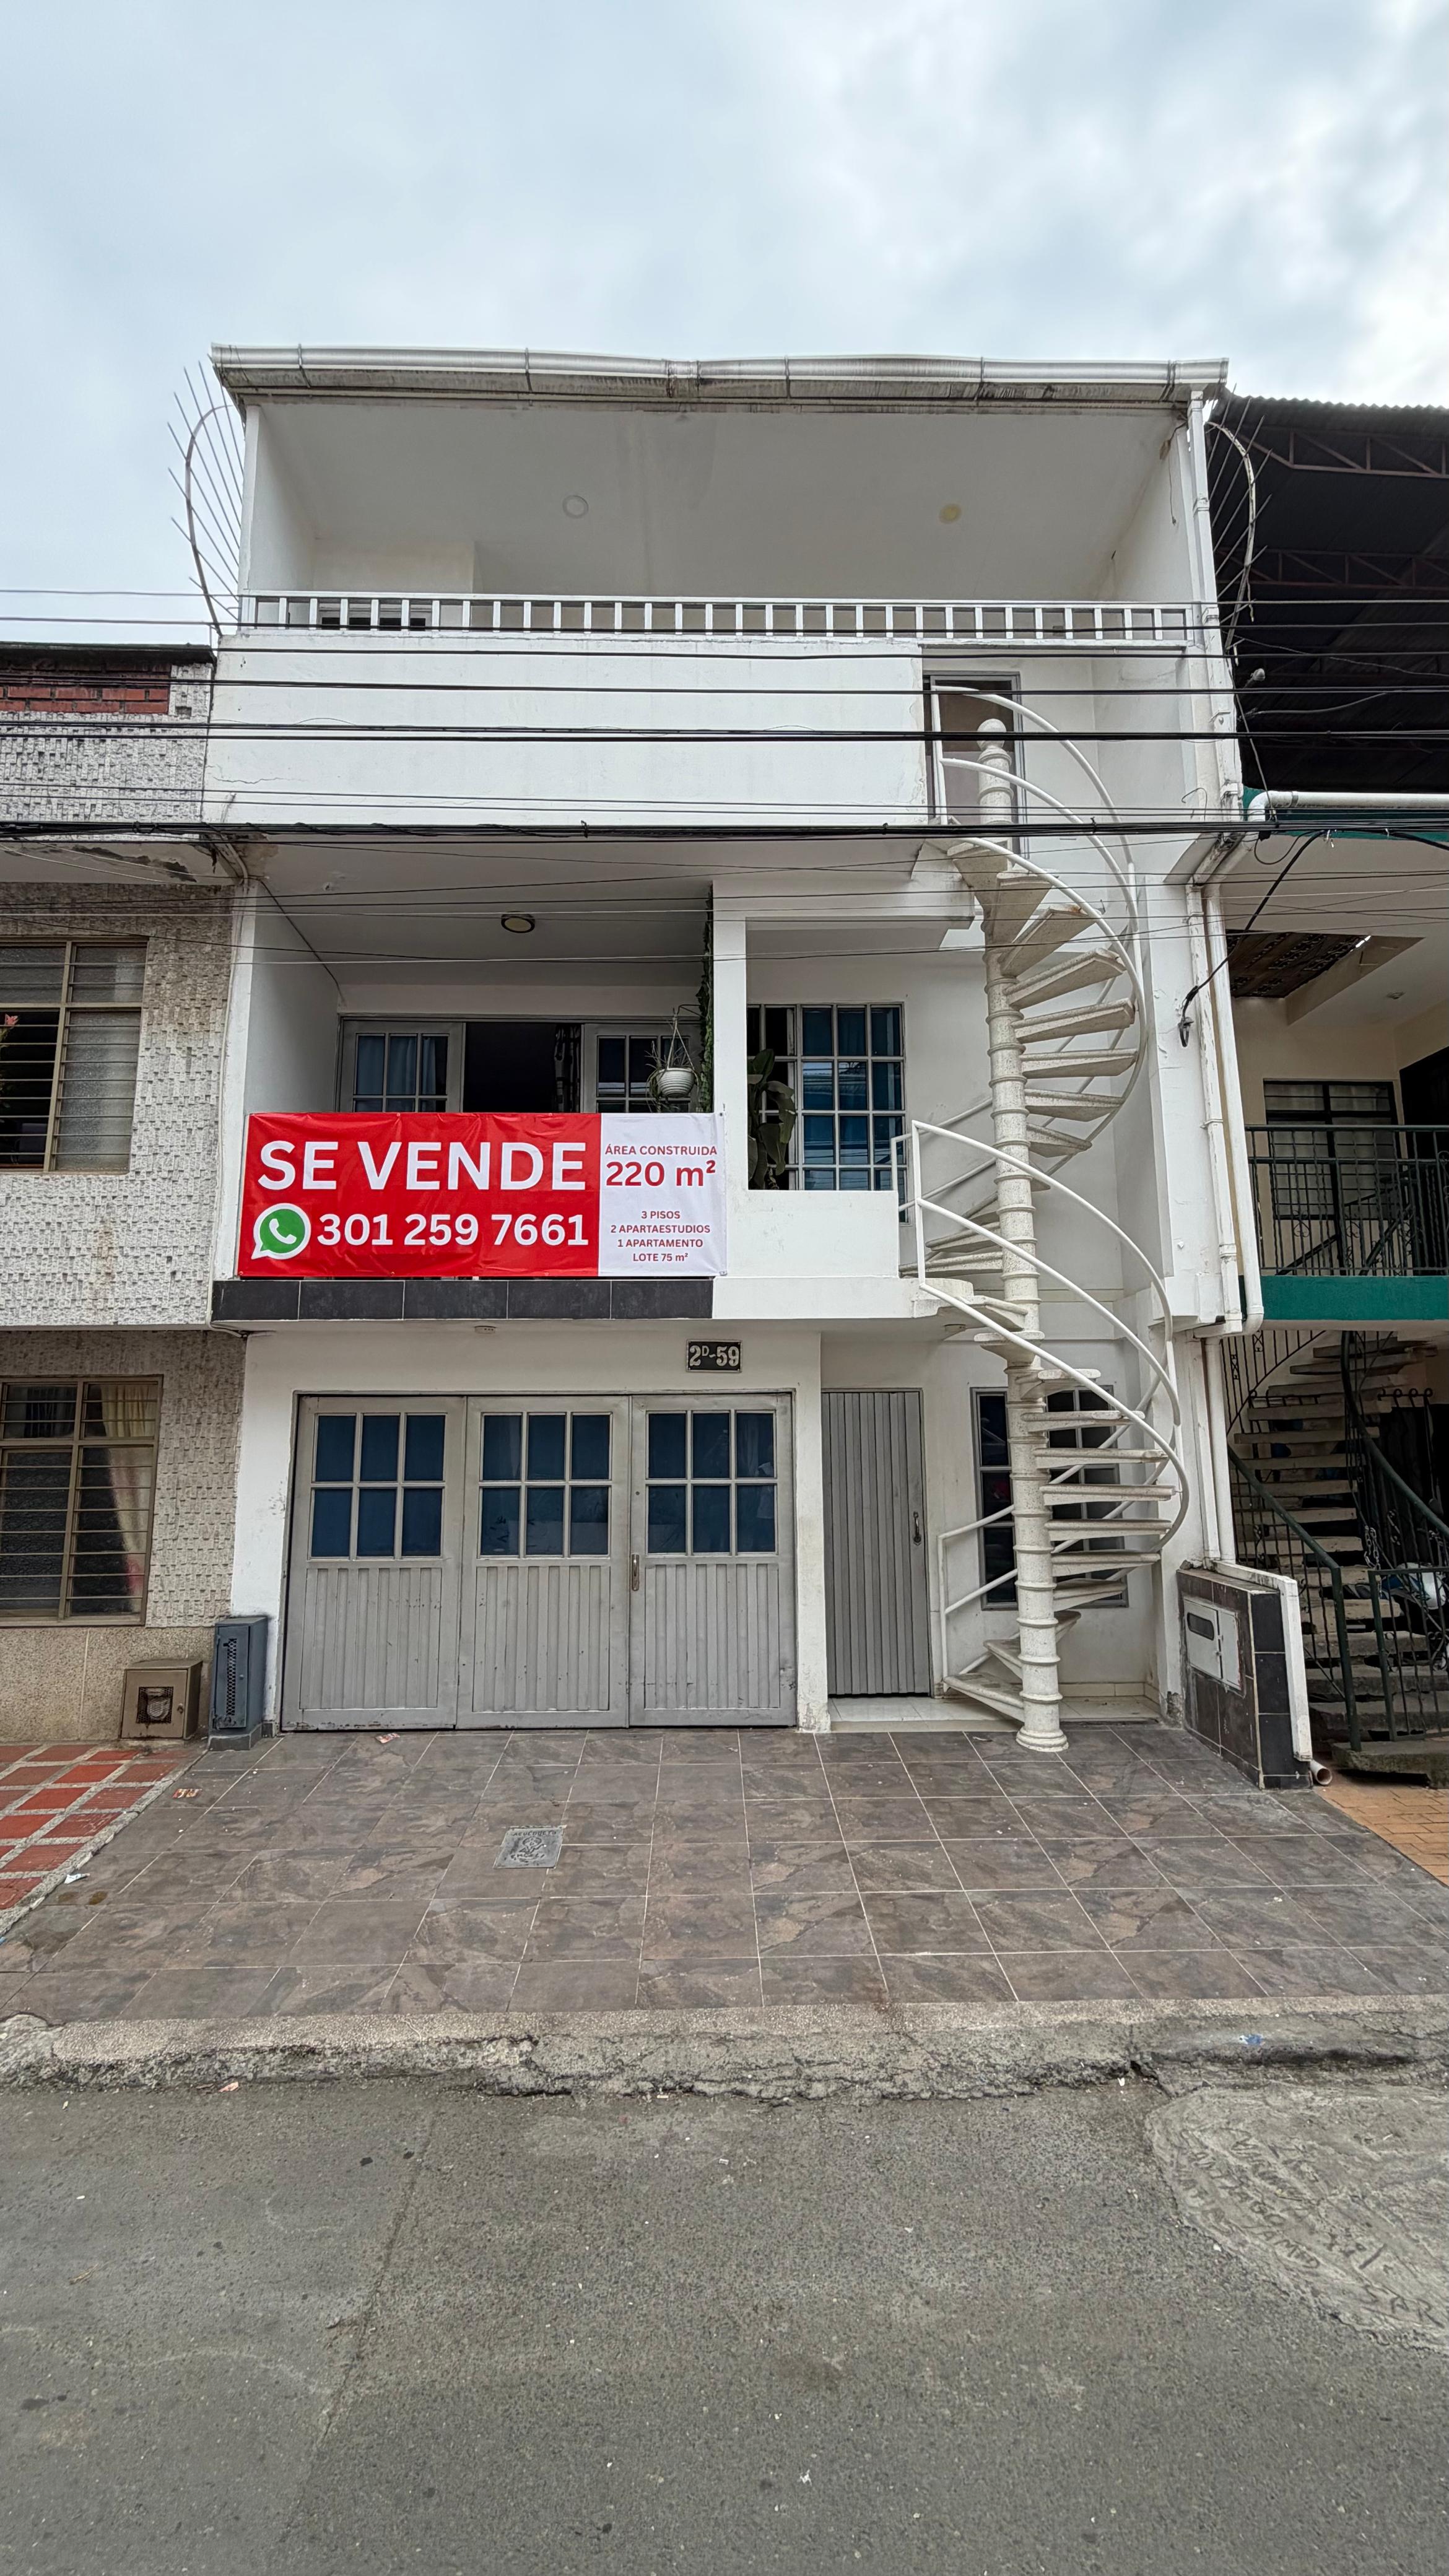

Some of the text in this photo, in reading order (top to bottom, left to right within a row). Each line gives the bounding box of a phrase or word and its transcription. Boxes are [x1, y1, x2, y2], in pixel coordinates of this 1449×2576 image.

[604, 1144, 718, 1155] ÁREA CONSTRUIDA
[257, 1140, 586, 1191] SE VENDE
[606, 1159, 716, 1186] 220 m²
[641, 1211, 681, 1219] 3 PISOS
[316, 1213, 590, 1247] 301 259 7661
[611, 1225, 710, 1234] 2 APARTAESTUDIOS
[617, 1239, 703, 1248] 1 APARTAMENTO
[633, 1253, 689, 1262] LOTE 75 m²
